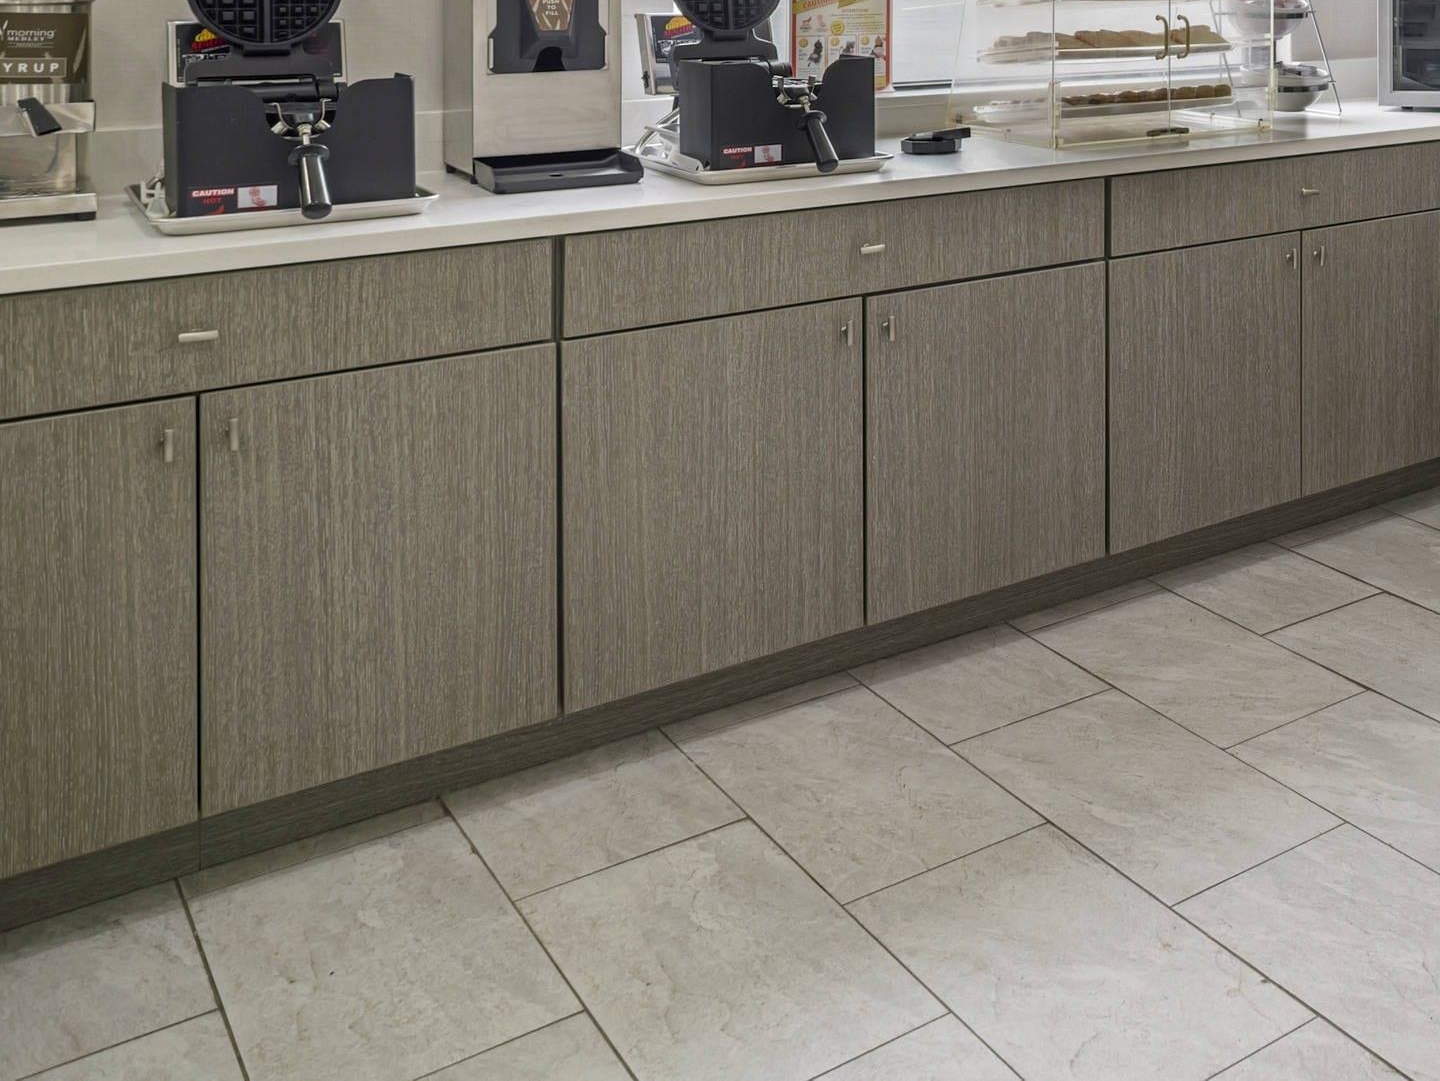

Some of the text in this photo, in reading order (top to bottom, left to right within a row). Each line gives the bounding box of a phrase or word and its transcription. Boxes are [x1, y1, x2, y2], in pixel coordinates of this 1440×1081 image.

[7, 29, 56, 40] morning
[723, 147, 753, 155] CAUTION
[191, 188, 235, 198] CAUTION
